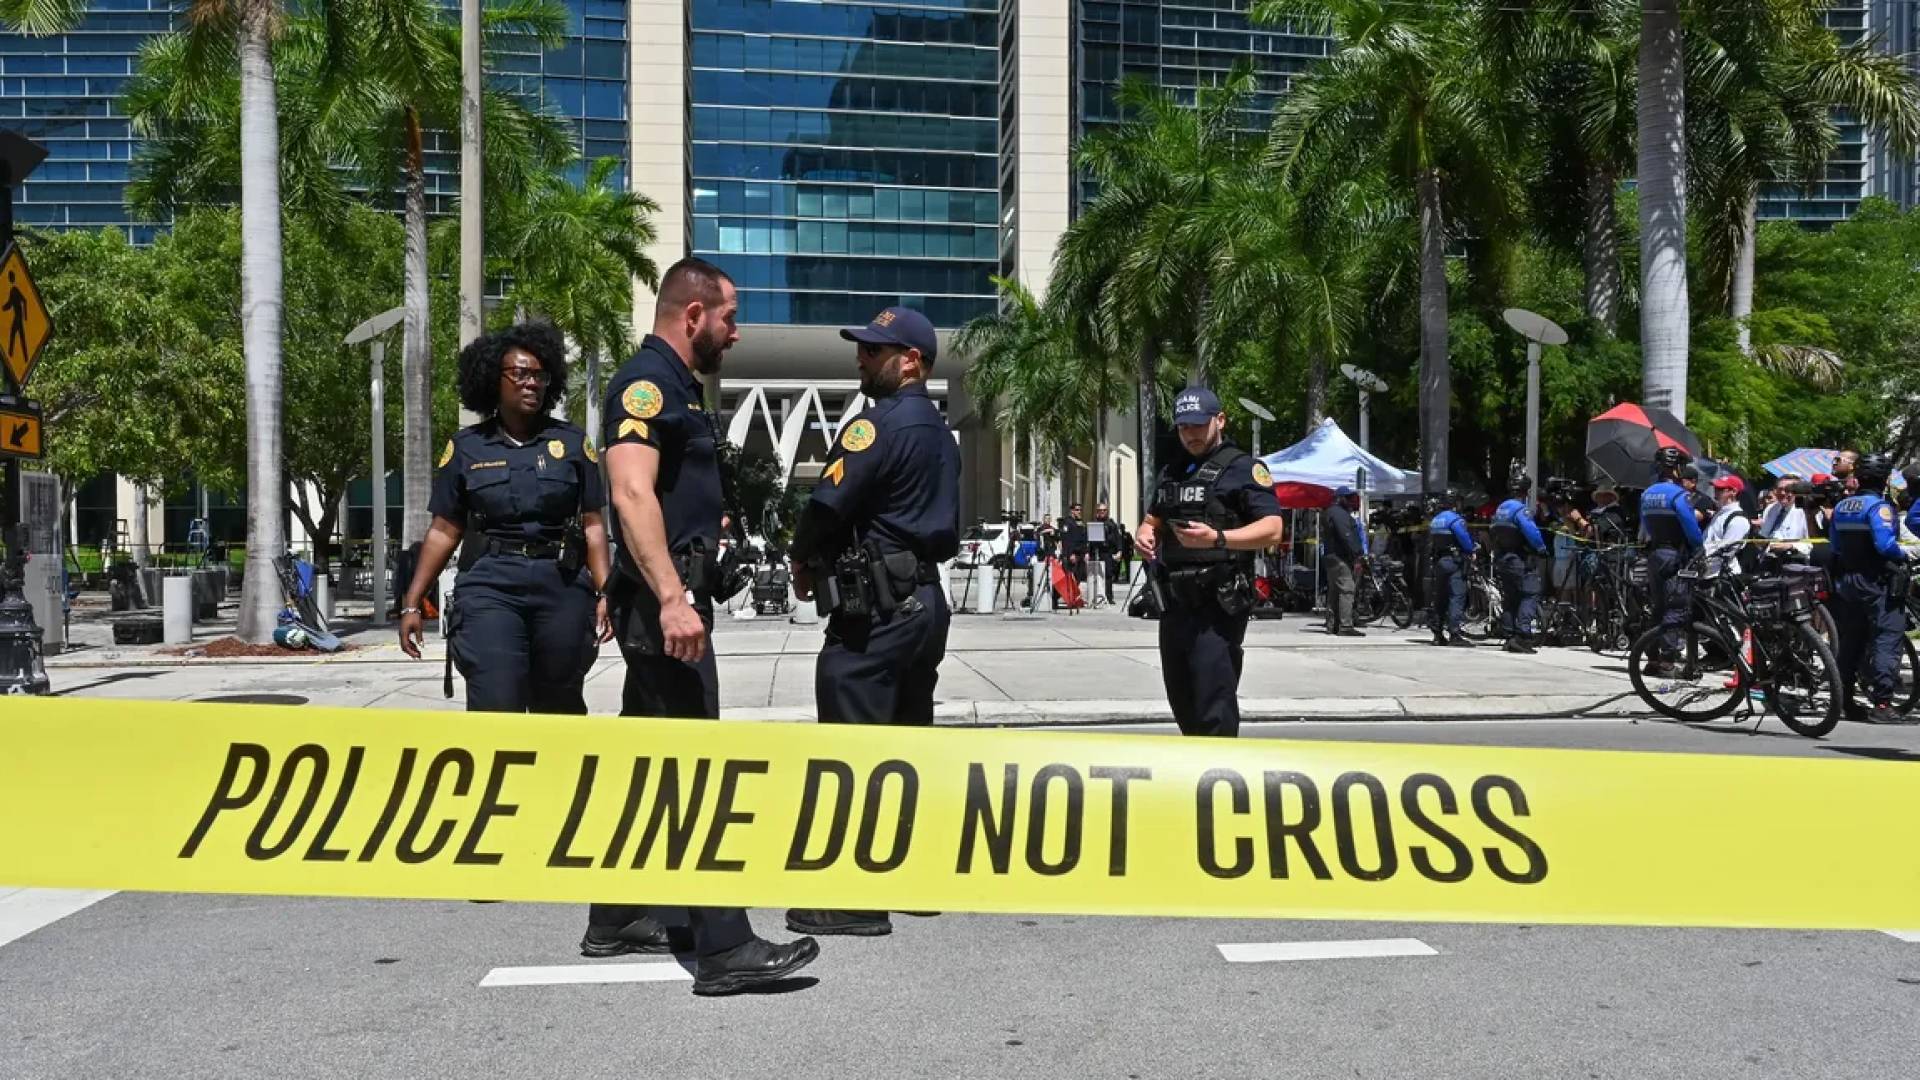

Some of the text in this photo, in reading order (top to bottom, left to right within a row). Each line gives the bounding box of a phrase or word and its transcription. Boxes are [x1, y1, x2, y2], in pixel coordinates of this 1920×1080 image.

[1157, 486, 1205, 503] PICE
[178, 743, 1548, 883] POLICE LINE DO NOT CROSS
